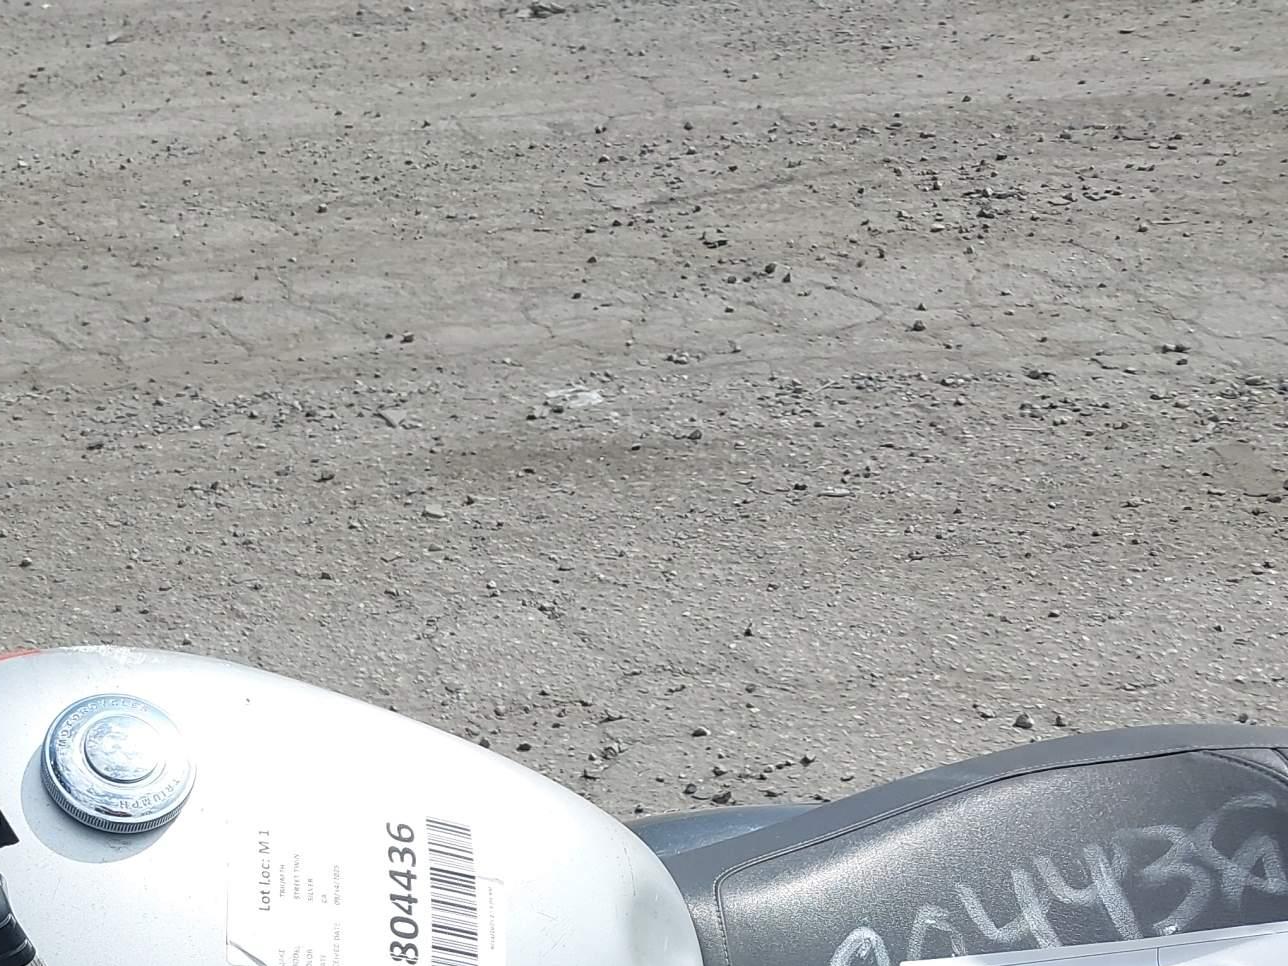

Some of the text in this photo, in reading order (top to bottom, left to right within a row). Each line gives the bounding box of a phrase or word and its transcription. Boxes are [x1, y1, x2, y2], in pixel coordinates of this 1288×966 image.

[258, 840, 271, 855] M
[258, 889, 271, 912] Lot
[385, 821, 420, 966] 804436
